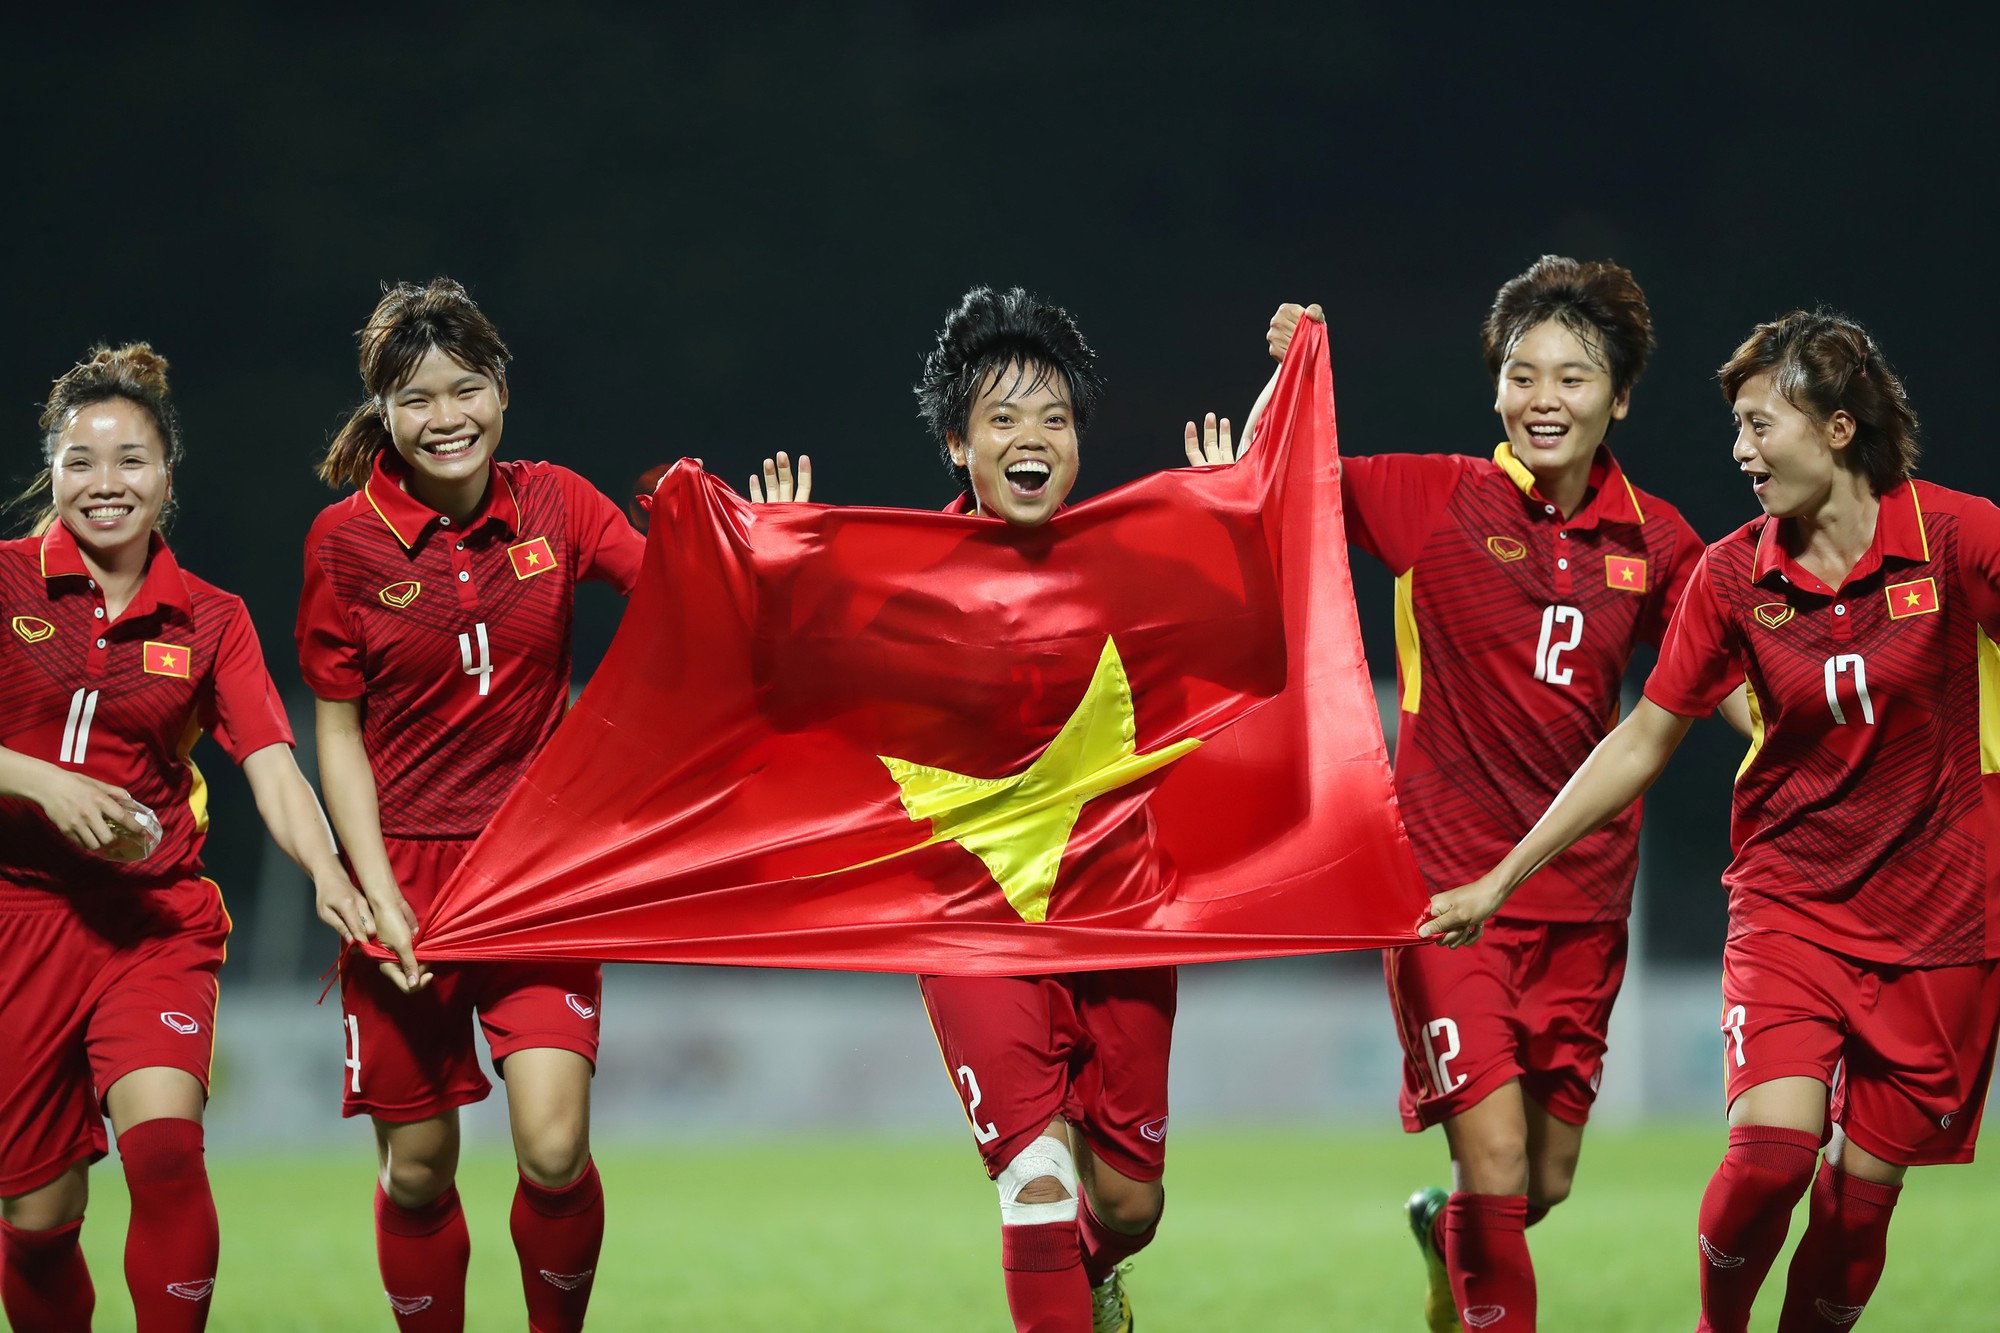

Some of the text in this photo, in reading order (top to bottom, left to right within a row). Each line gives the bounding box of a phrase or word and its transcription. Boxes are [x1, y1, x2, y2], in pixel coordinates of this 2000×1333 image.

[458, 622, 494, 696] 4
[1533, 605, 1583, 686] 12
[59, 687, 99, 765] 11
[1824, 654, 1875, 724] 17
[1422, 1018, 1467, 1096] 12
[957, 1065, 999, 1145] 2
